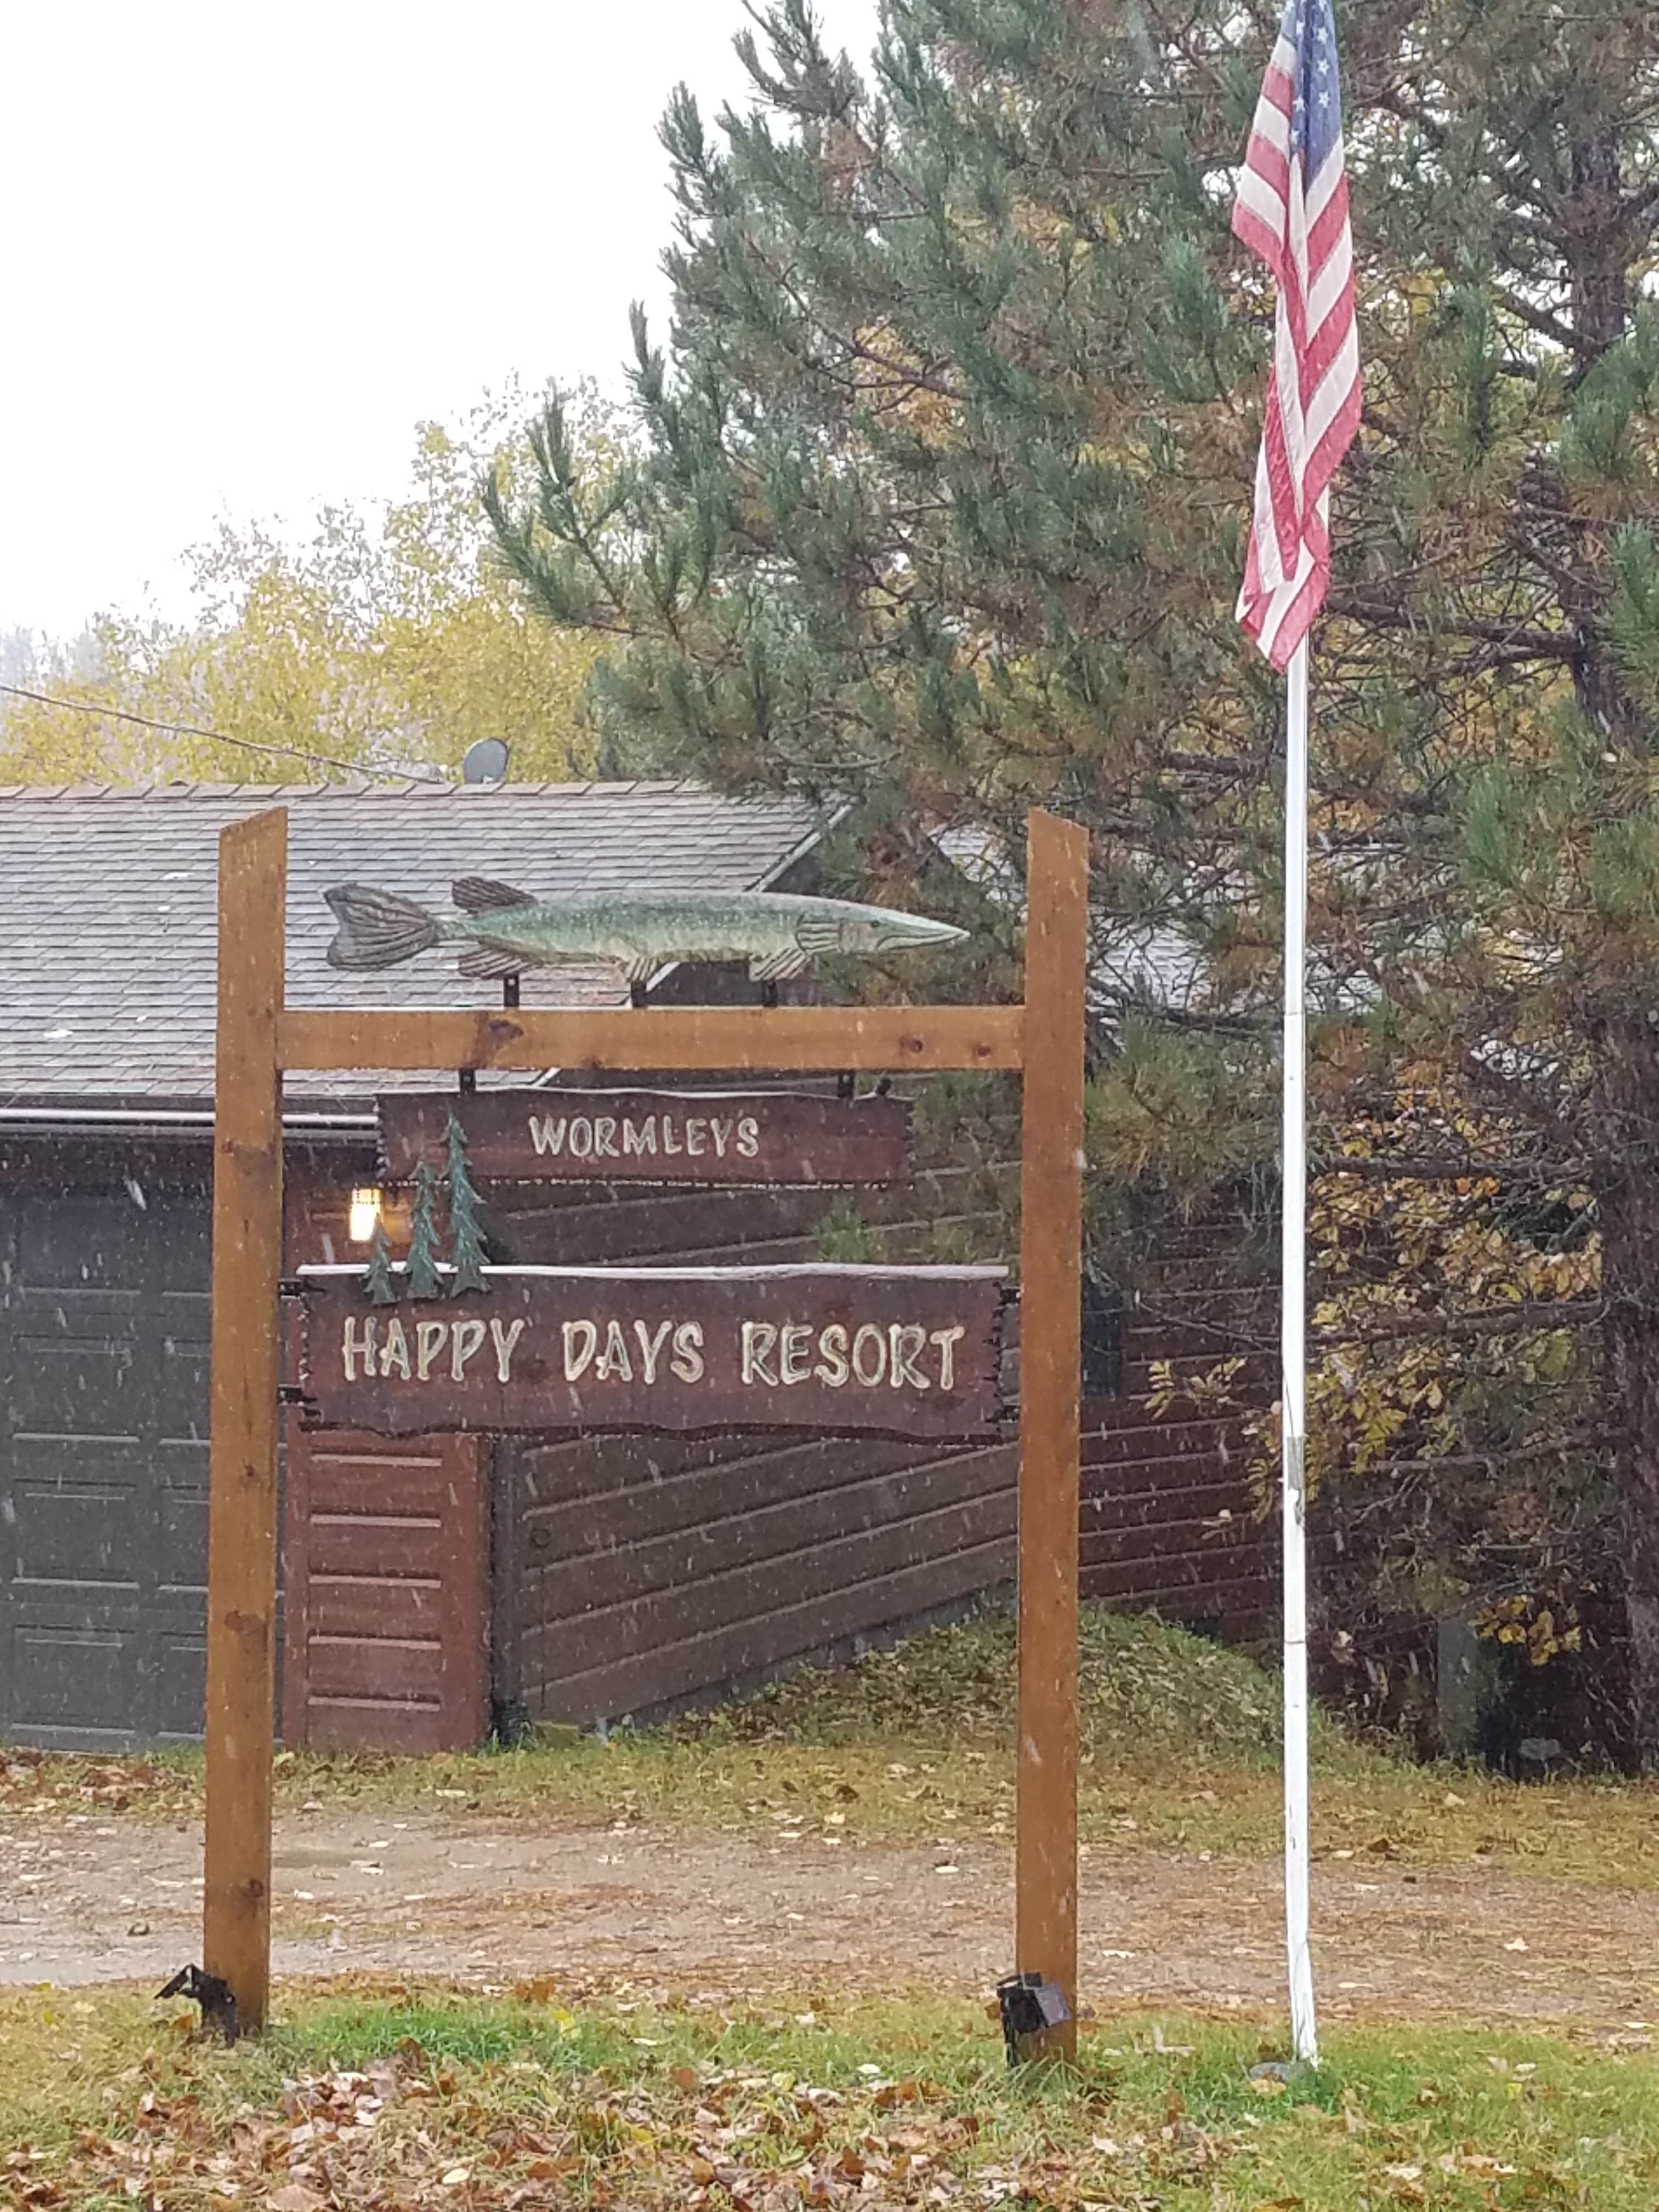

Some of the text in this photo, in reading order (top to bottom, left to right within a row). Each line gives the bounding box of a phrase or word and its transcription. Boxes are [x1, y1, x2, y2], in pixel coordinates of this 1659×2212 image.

[342, 1317, 964, 1390] HAPPY DAYS RESORT
